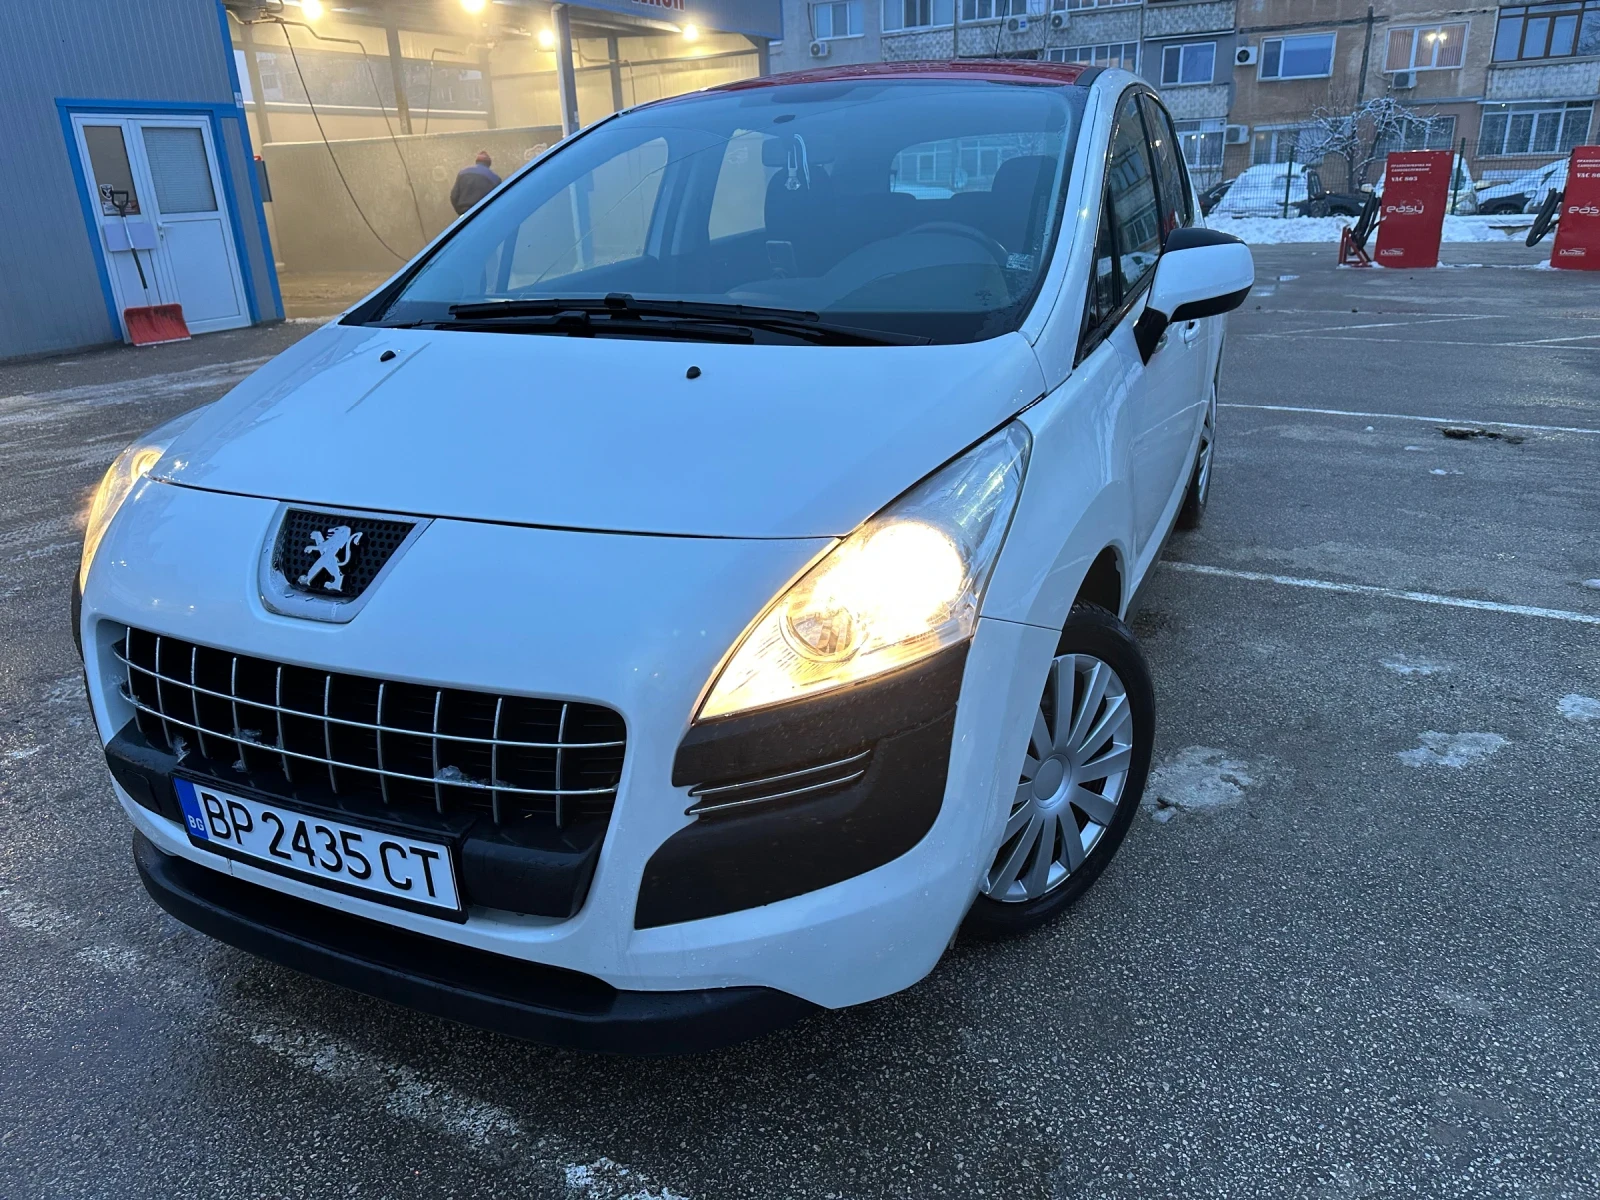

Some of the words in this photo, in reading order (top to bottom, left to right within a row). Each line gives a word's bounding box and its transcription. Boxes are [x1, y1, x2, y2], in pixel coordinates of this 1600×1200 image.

[1386, 205, 1424, 214] easy
[188, 814, 205, 831] BG
[201, 791, 254, 845] BP
[261, 811, 372, 880] 2435
[379, 841, 439, 898] CT
